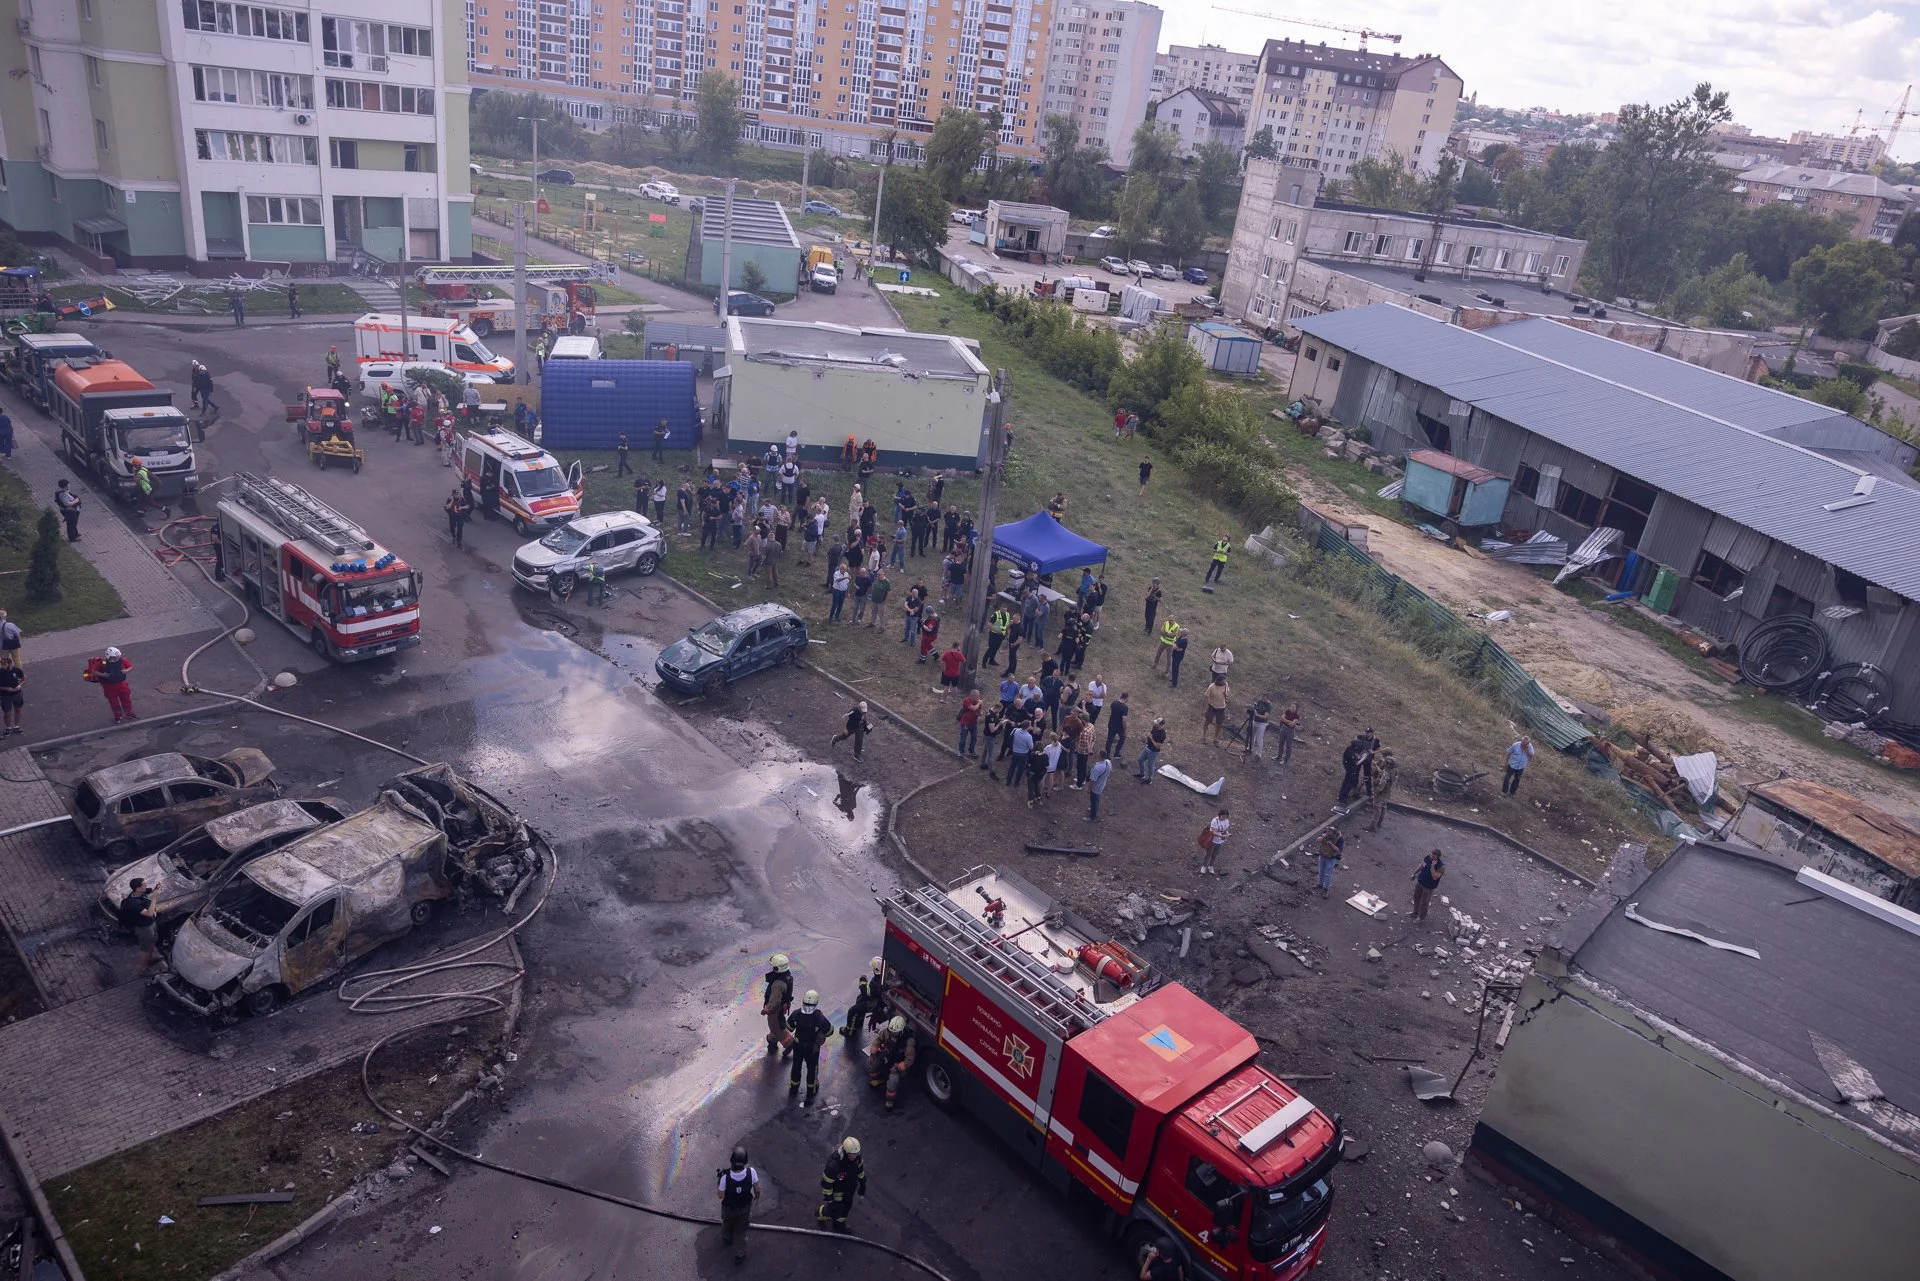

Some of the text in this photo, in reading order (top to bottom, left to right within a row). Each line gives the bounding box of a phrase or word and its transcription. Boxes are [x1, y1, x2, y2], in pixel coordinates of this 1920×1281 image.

[376, 630, 393, 638] IVECO
[976, 1005, 1003, 1028] ПОЖЕЖНО-
[972, 1017, 1001, 1044] РЯТУВАЛЬНА
[979, 1038, 998, 1057] СЛУЖБА
[1198, 1230, 1209, 1244] 4
